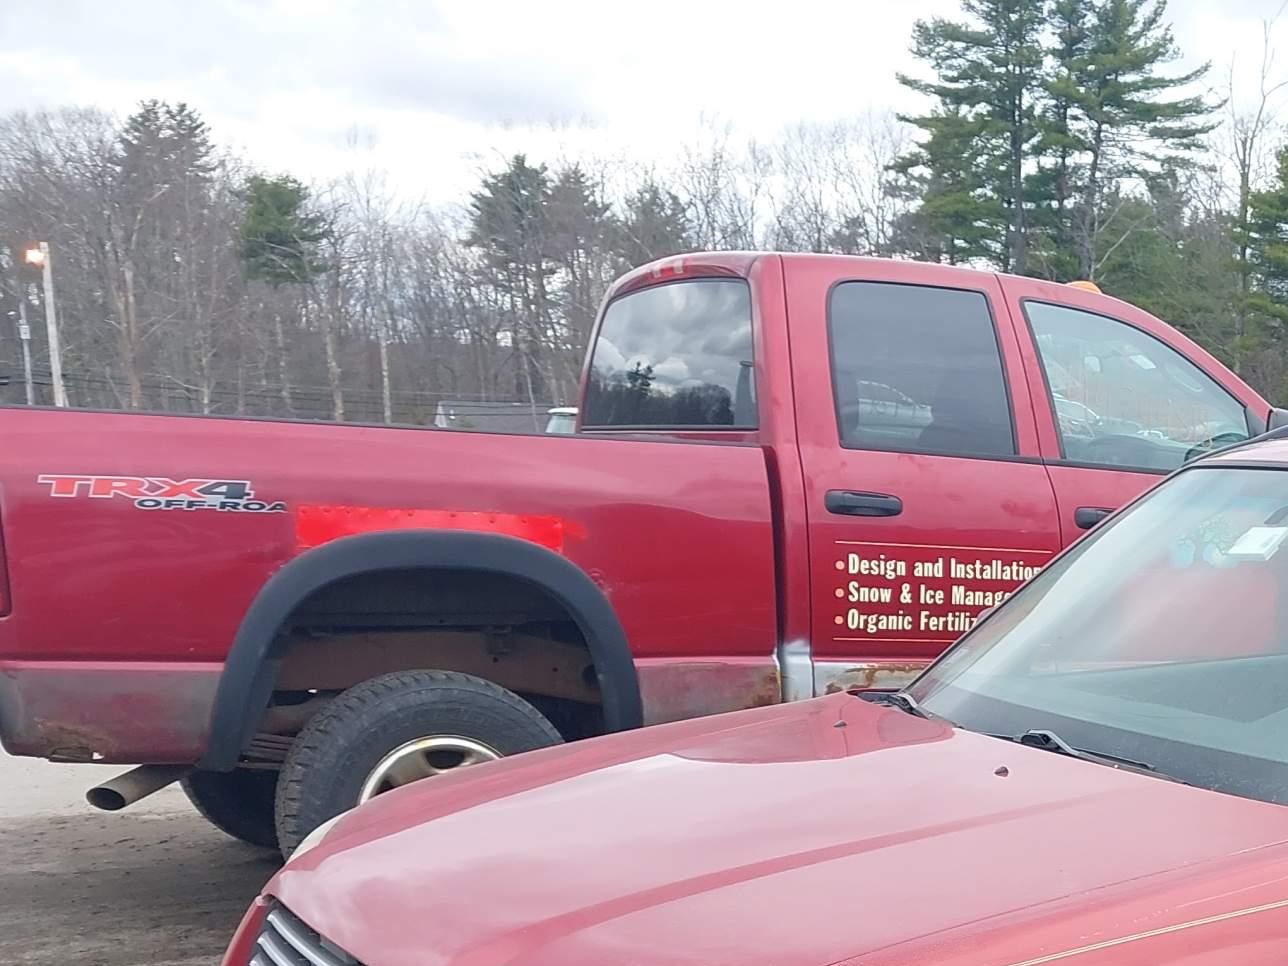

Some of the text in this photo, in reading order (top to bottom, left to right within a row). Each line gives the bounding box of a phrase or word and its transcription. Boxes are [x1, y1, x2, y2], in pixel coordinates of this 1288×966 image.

[38, 475, 254, 499] TRX4
[848, 553, 906, 579] Design
[914, 557, 943, 578] and
[848, 581, 892, 602] Snow
[900, 583, 912, 604] &
[919, 584, 944, 604] Ice
[847, 608, 912, 633] Organic
